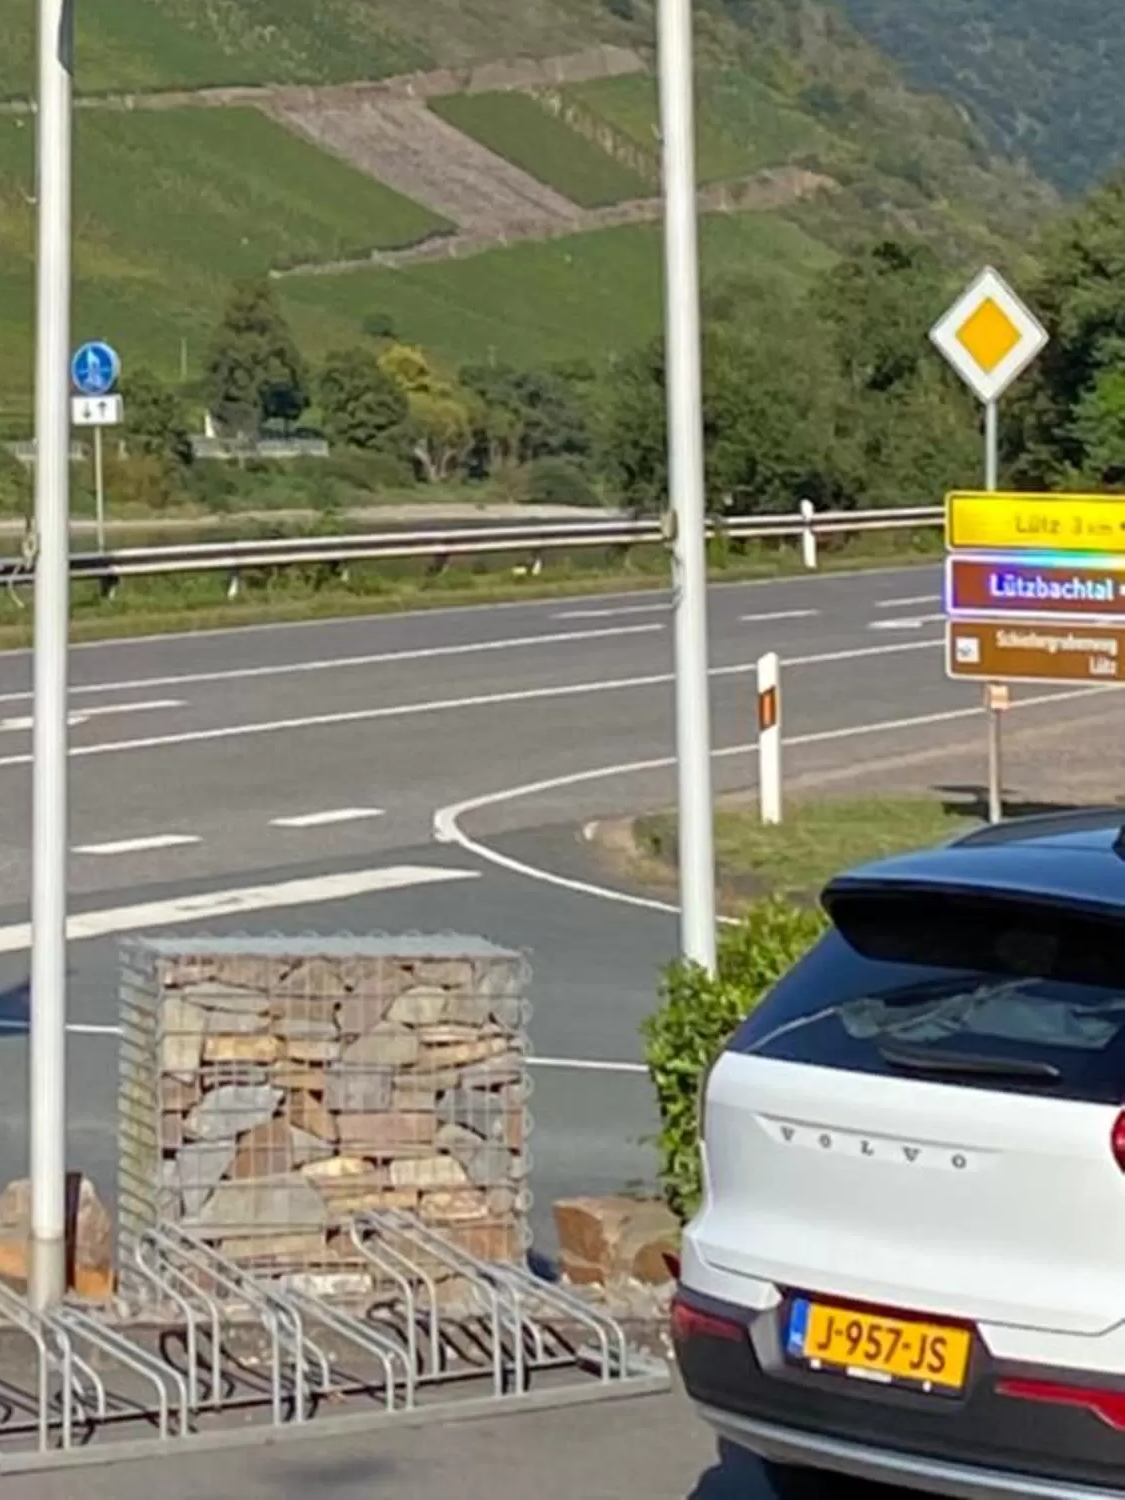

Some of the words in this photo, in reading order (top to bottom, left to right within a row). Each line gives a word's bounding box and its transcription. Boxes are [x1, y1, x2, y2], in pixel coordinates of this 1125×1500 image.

[1014, 513, 1061, 534] Lütz
[988, 573, 1115, 601] Lützbachtal
[780, 1125, 968, 1169] VOLVO
[816, 1315, 948, 1374] J-957-JS
